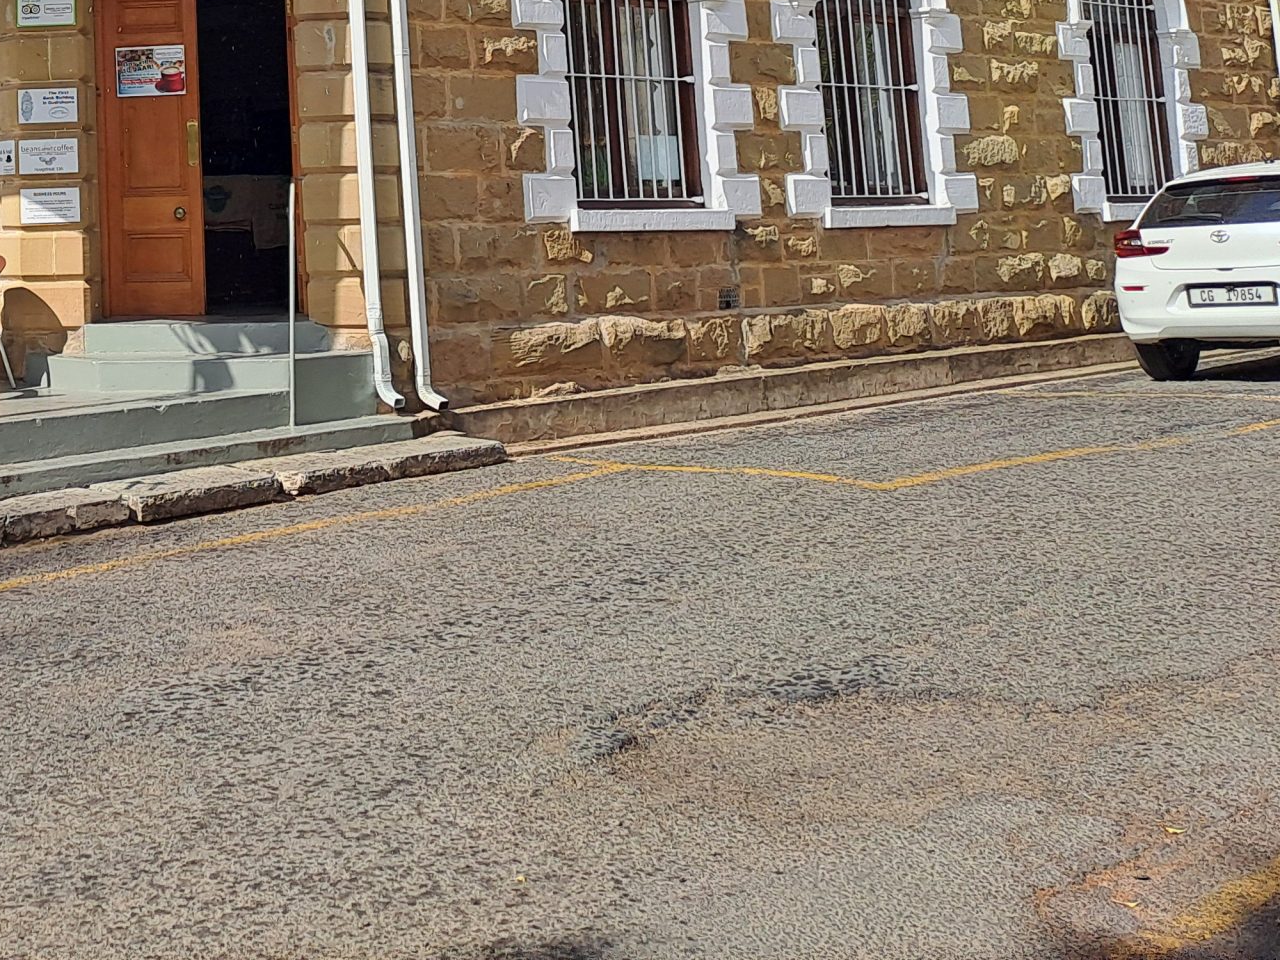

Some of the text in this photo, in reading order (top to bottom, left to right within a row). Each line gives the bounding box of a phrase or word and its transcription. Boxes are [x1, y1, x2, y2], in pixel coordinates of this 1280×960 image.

[53, 143, 74, 152] coffee
[1200, 287, 1262, 303] CG 19854
